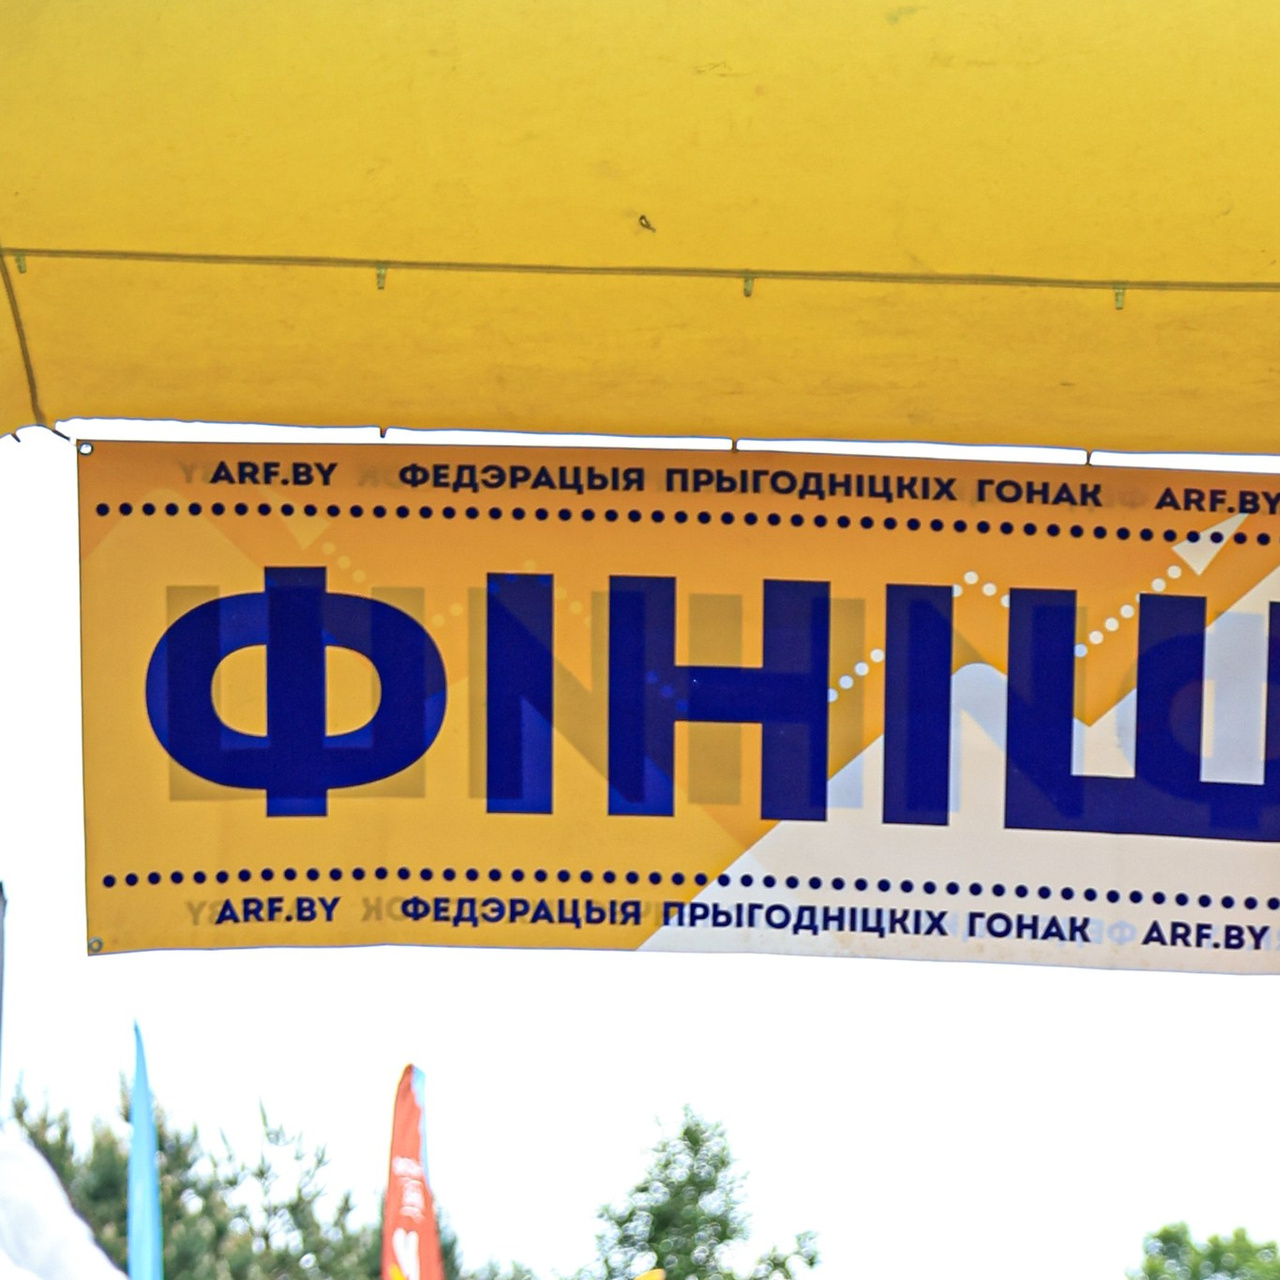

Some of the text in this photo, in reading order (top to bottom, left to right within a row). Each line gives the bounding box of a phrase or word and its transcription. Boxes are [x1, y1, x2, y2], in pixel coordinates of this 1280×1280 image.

[209, 461, 338, 487] ARF.BY
[399, 464, 645, 493] ФЕДЭРАЦЫЯ
[665, 468, 957, 502] ПРЫГОДНІЦКІХ
[976, 478, 1102, 508] ГОНАК
[215, 896, 1271, 951] ARF.BY ФЕДЭРАЦЫЯ ПРЫГОДНІЦКІХ ГОНАК ARF.BY
